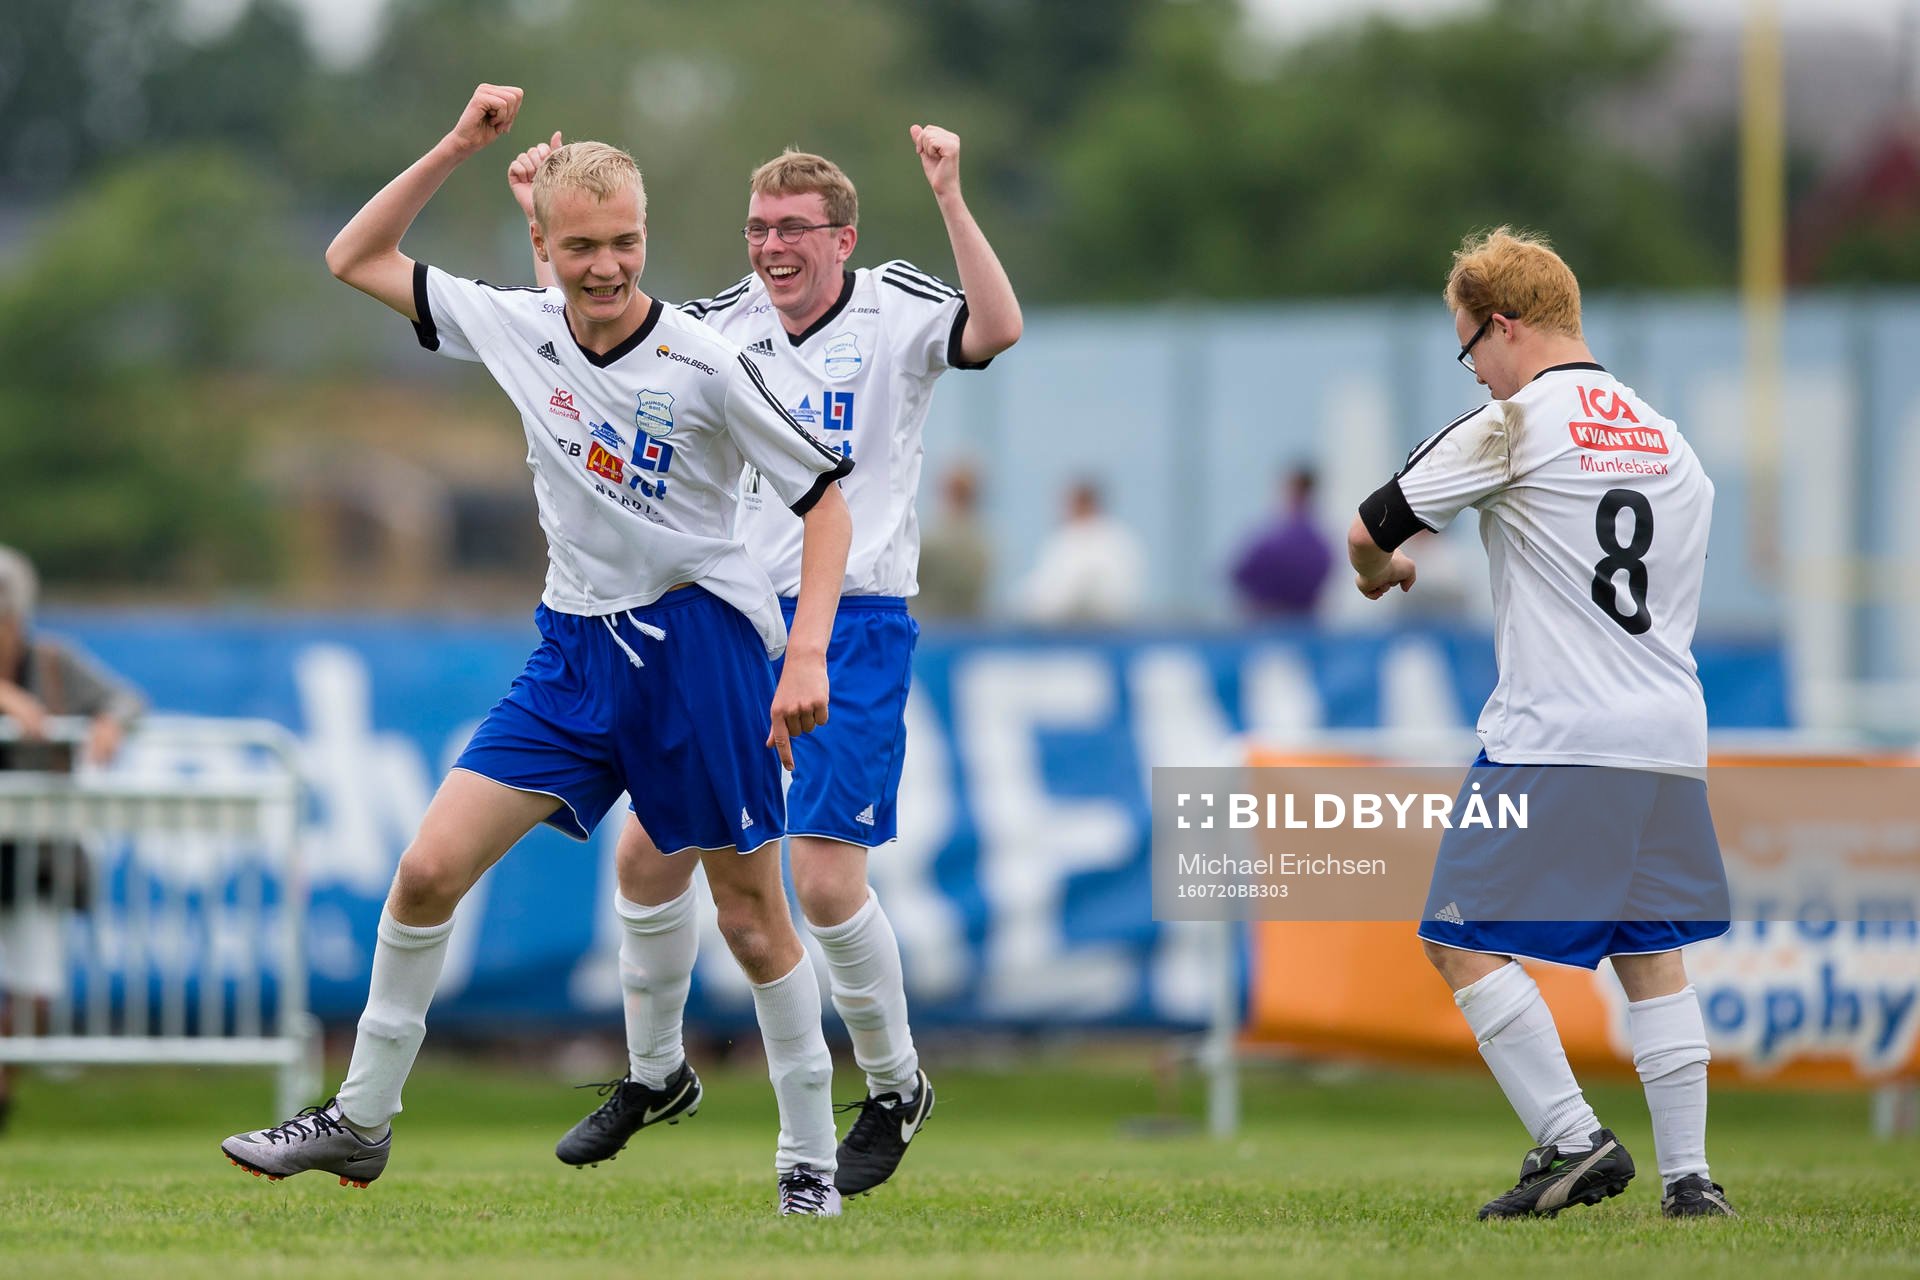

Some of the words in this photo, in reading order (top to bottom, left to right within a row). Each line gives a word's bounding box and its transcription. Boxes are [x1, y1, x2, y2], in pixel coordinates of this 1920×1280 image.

[537, 348, 560, 365] adidas
[746, 345, 776, 357] adidas
[669, 352, 715, 376] SOHLBERG
[1576, 385, 1640, 423] ICA
[1575, 426, 1662, 449] KVANTUM
[1580, 454, 1668, 475] Munkebäck
[1591, 488, 1654, 636] 8
